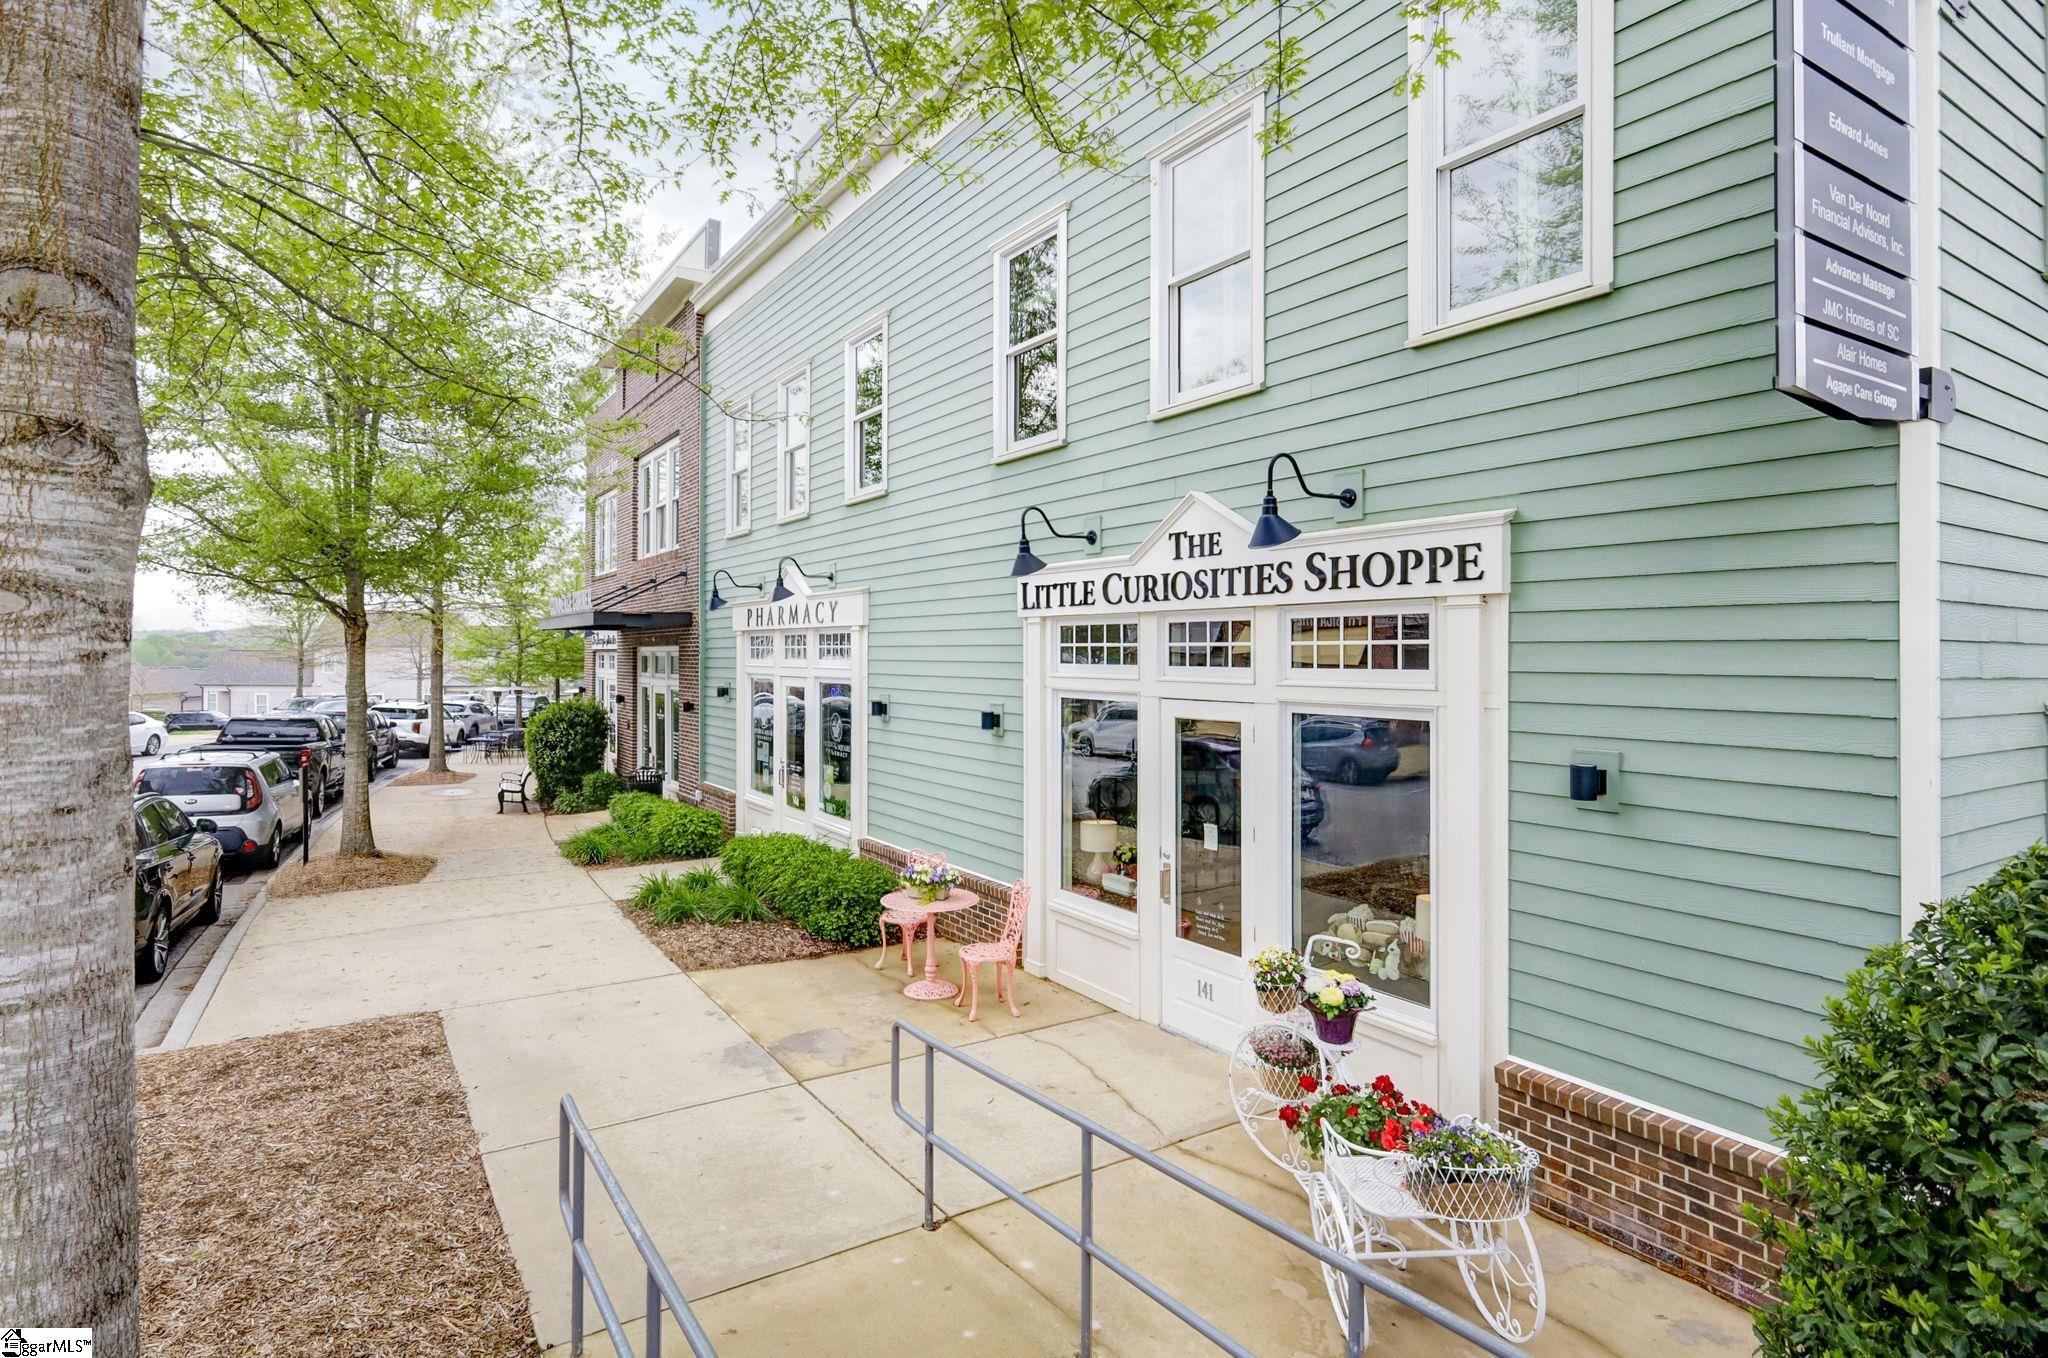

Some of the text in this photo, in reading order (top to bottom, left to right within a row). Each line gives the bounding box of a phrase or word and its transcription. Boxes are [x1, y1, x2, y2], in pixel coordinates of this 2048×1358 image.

[1820, 21, 1896, 85] Truliant Mortgage
[1828, 111, 1889, 160] Edward Jones
[1812, 198, 1906, 257] Financial Advisors, Inc.
[1829, 183, 1891, 229] Van Der Noord
[1825, 257, 1896, 301] Advance Massage
[1822, 298, 1900, 342] JMC Homes of SC
[1836, 342, 1888, 374] Alair Homes
[1826, 374, 1898, 412] Agape Care Group
[1168, 530, 1223, 561] THE
[1020, 542, 1486, 611] LITTLE CURIOSITIES SHOPPE
[746, 600, 839, 628] PHARMACY
[1197, 979, 1214, 1002] 141
